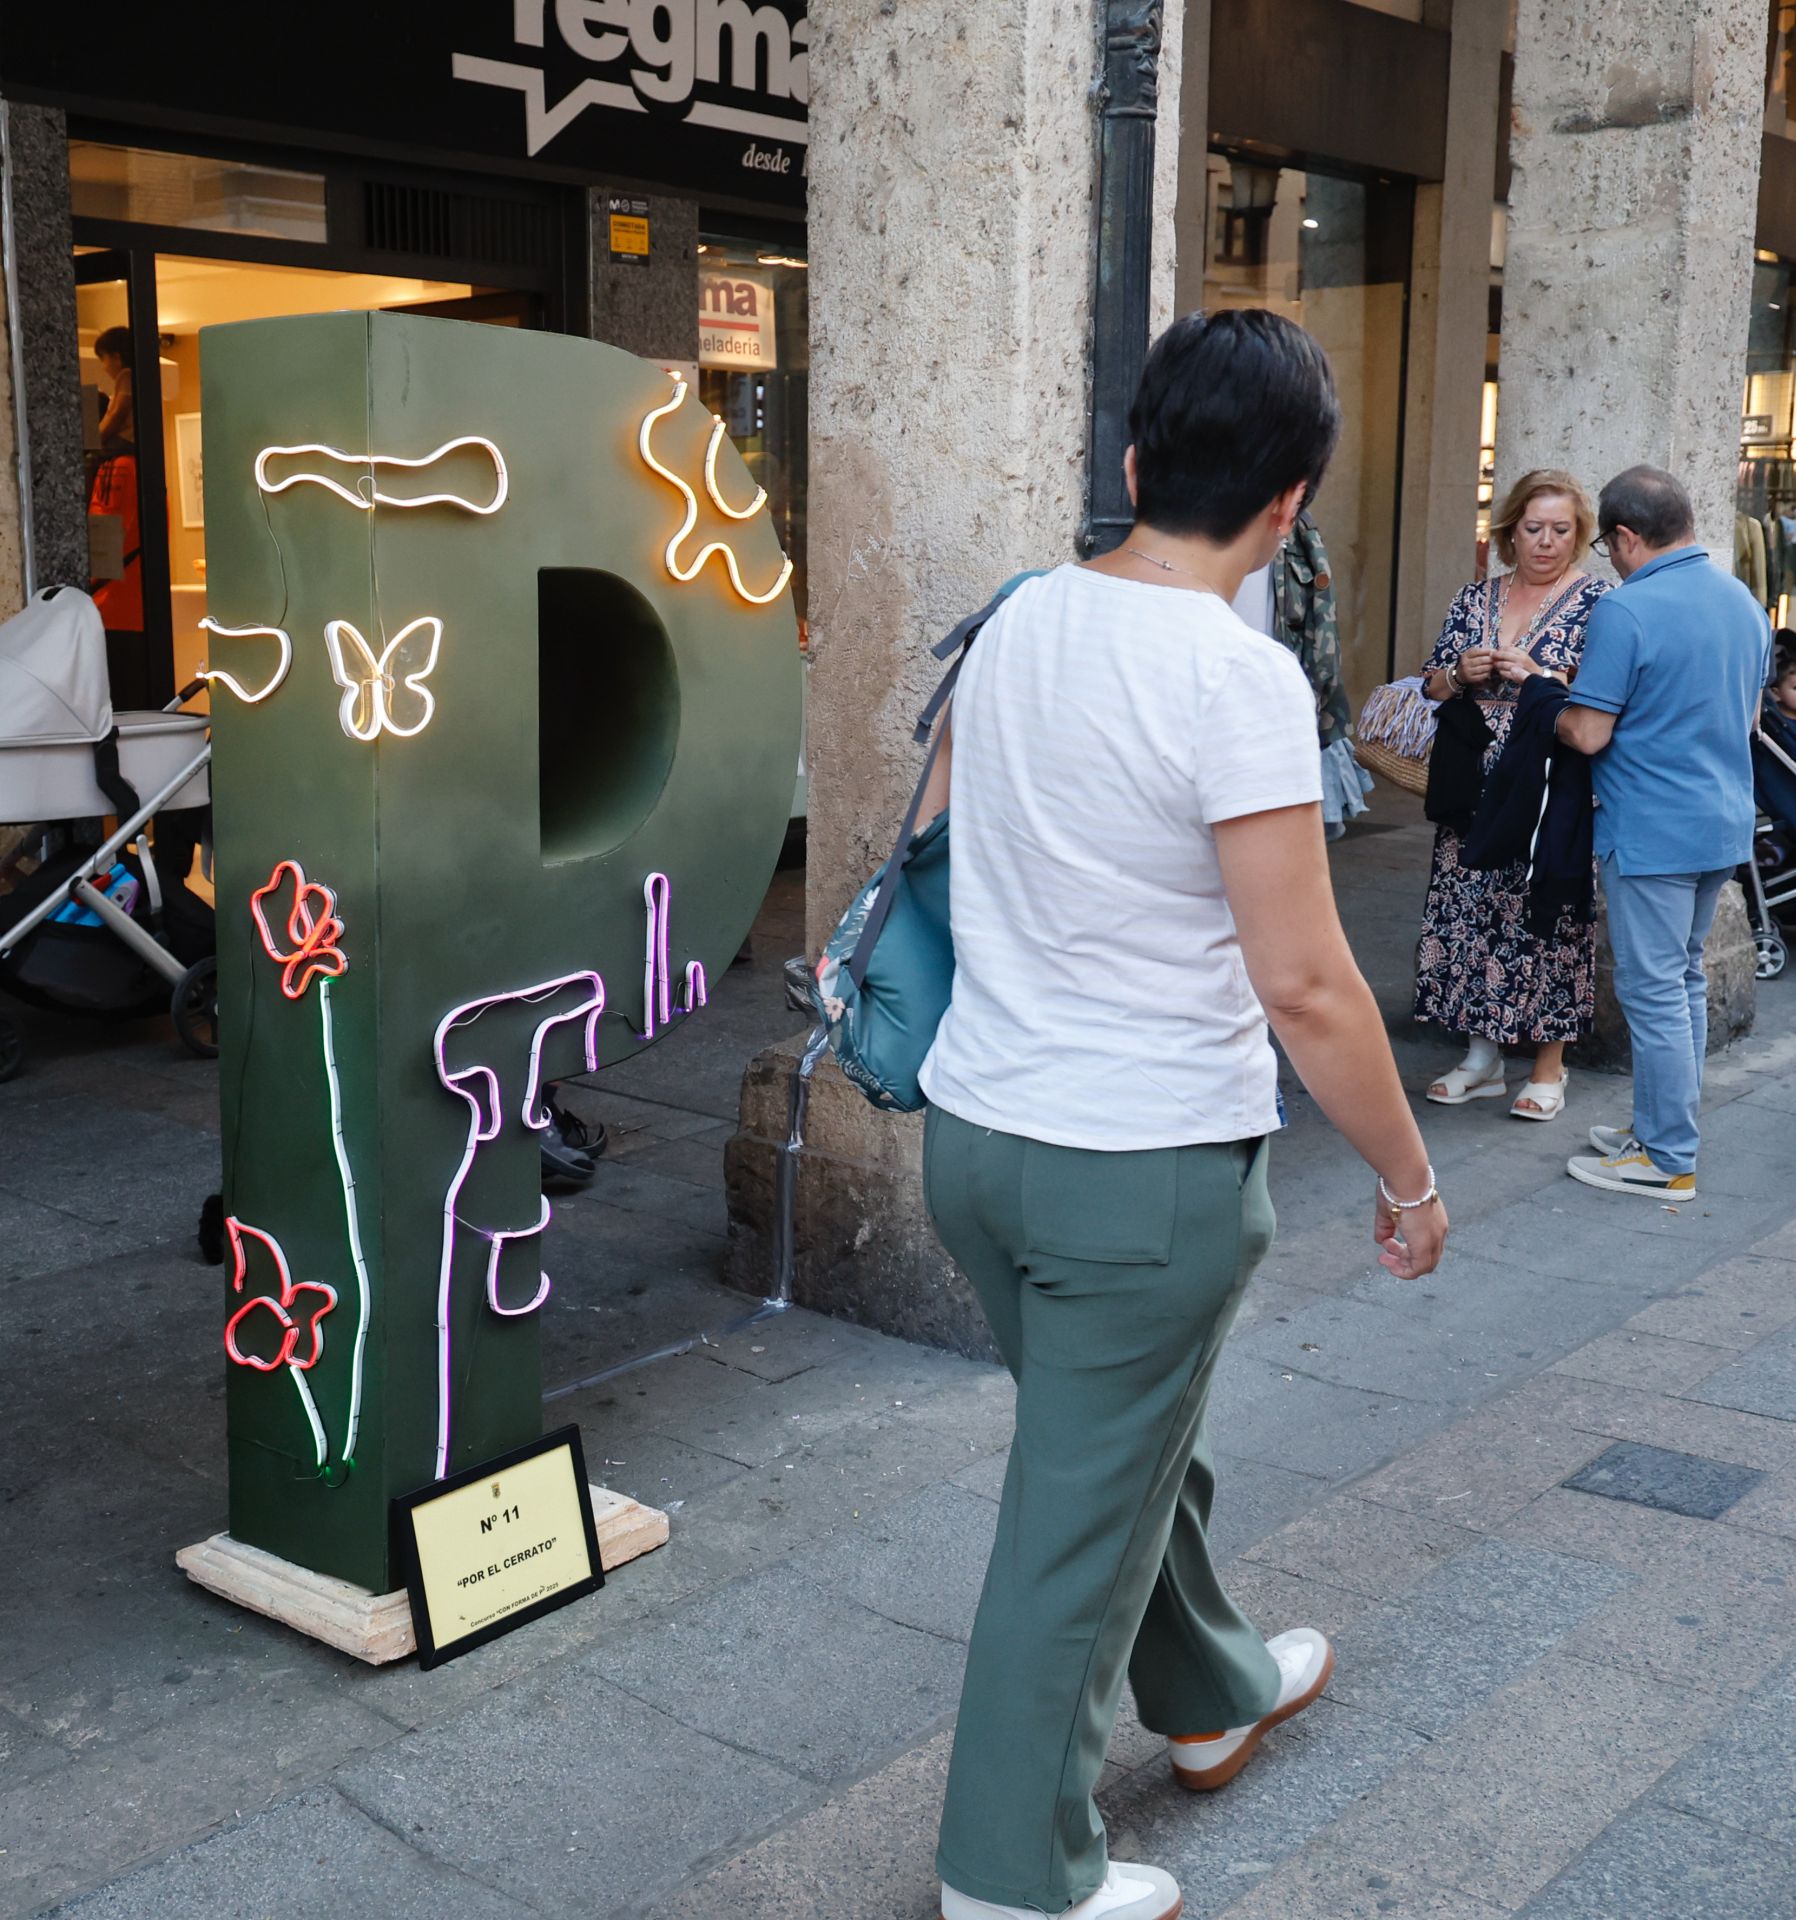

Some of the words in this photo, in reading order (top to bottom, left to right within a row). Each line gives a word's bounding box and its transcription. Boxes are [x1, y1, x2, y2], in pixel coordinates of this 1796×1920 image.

[742, 143, 791, 174] desde
[480, 1514, 497, 1534] Nº
[502, 1505, 520, 1524] 11
[457, 1570, 485, 1588] “POR
[487, 1564, 501, 1577] EL
[503, 1537, 557, 1569] CERRATO”
[470, 1613, 496, 1628] Concurso
[511, 1595, 530, 1609] FORMA
[531, 1591, 539, 1599] DE
